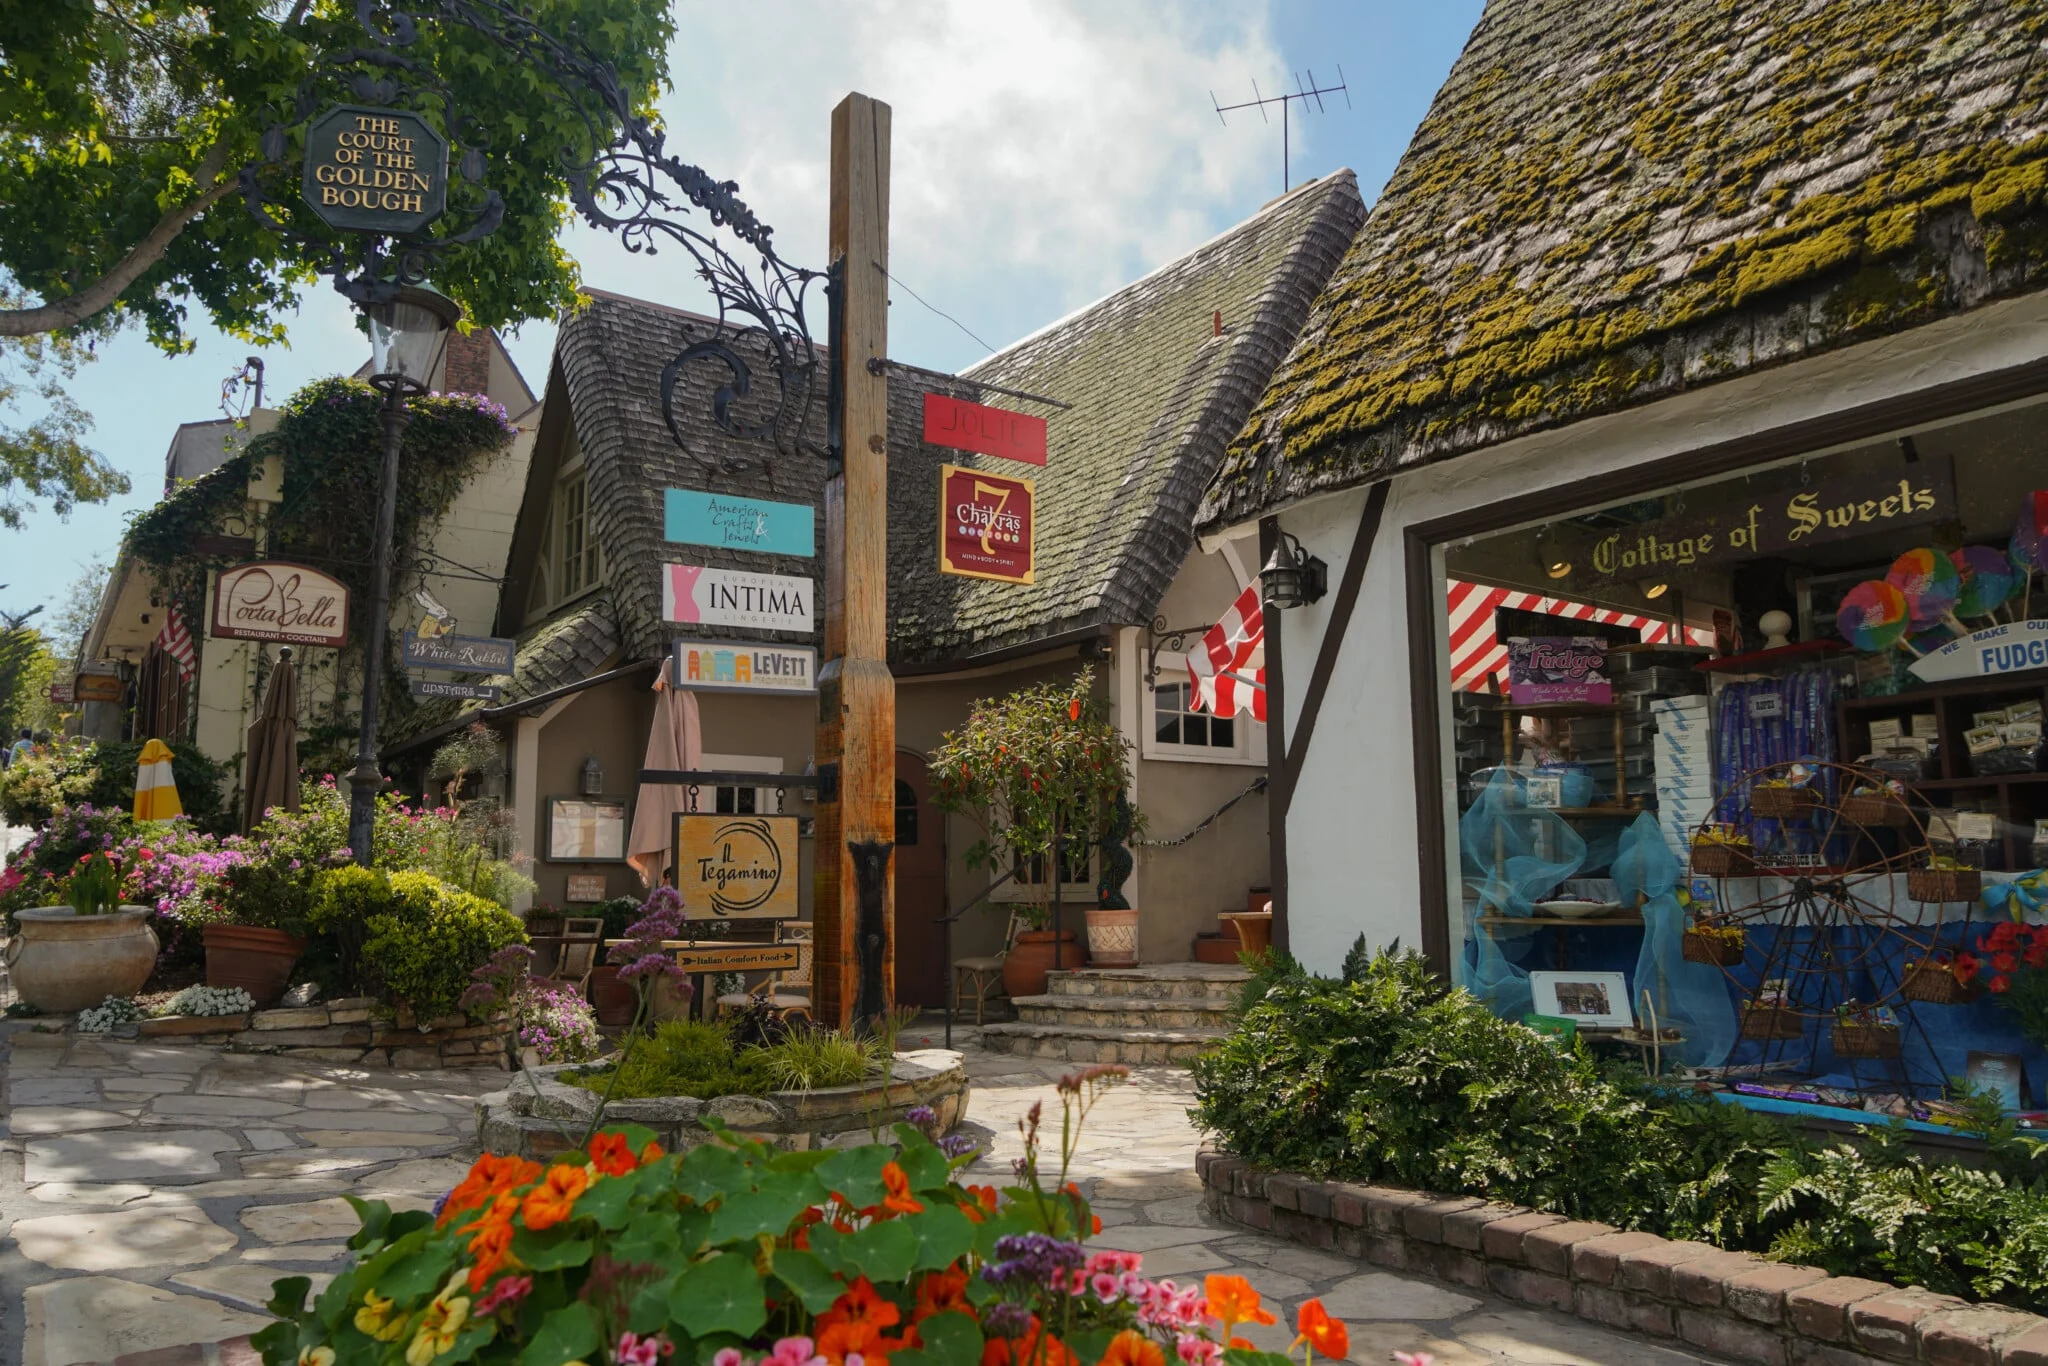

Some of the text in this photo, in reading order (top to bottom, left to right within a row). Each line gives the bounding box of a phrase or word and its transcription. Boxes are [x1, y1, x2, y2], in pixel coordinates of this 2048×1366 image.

[356, 116, 400, 135] THE
[338, 132, 414, 153] COURT
[335, 149, 416, 170] OF THE
[316, 165, 430, 192] GOLDEN
[322, 186, 423, 213] BOUGH
[707, 498, 768, 518] American
[956, 480, 1021, 555] 7 Chakras
[712, 512, 771, 541] Crafts &
[722, 526, 761, 544] Jewels
[1593, 479, 1936, 576] Cottage of Sweets
[723, 575, 794, 588] EUROPEAN
[226, 567, 337, 631] Porta Bella
[709, 582, 806, 616] INTIMA
[723, 614, 792, 625] LINGERIE
[234, 629, 327, 643] RESTAURANT COCKTAILS
[1941, 620, 2048, 656] WE MAKE OU
[409, 640, 507, 665] White Rabbit
[1528, 644, 1604, 678] Fudge
[422, 683, 474, 697] UPSTAIRS
[698, 858, 776, 890] Tegamino
[697, 951, 780, 966] Italian Comfort Food
